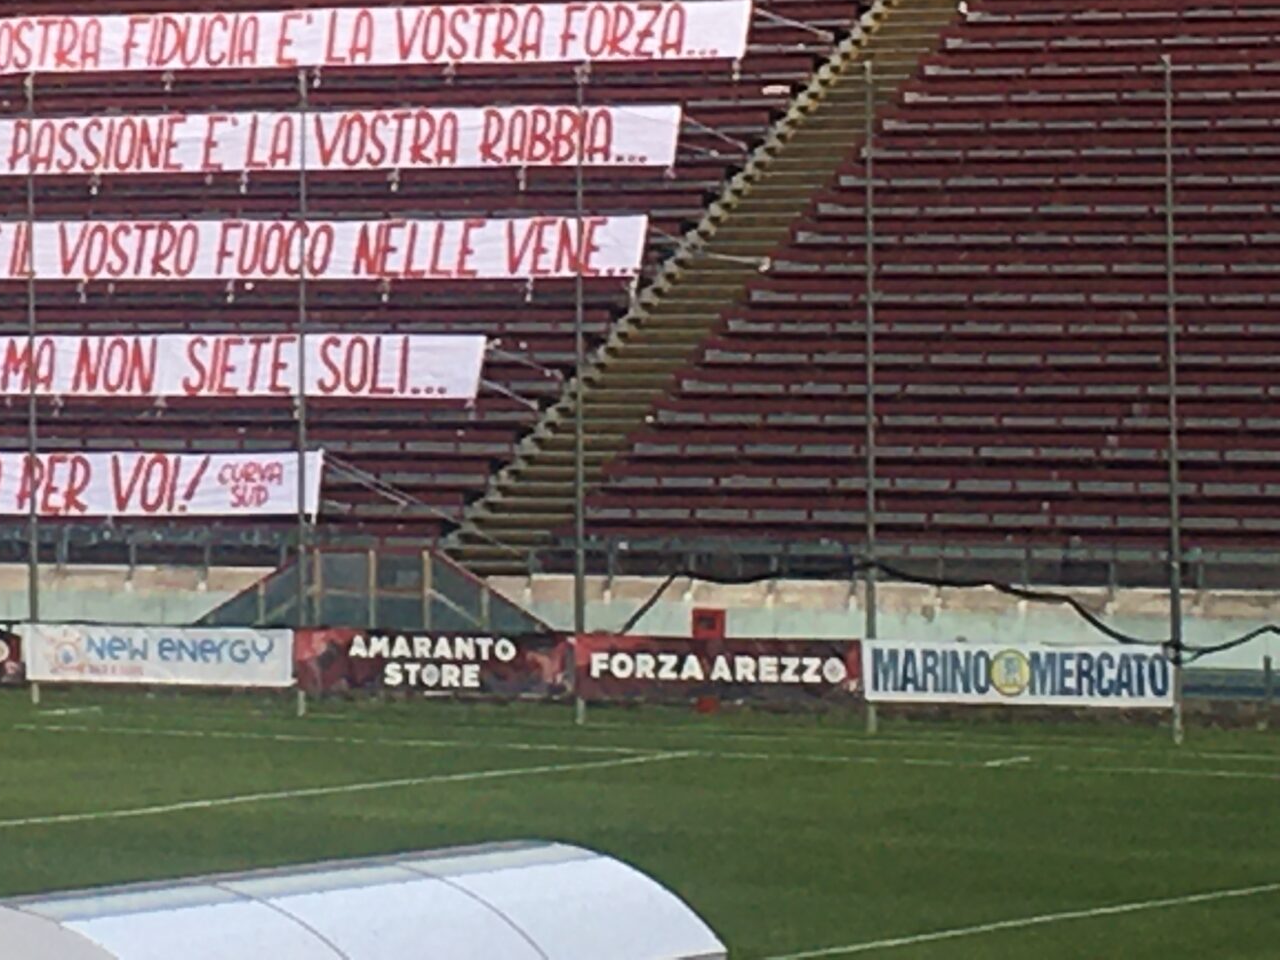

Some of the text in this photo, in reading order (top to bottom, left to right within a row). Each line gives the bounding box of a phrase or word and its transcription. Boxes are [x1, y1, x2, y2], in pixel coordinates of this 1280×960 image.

[122, 13, 260, 67] FIDUCIA
[325, 9, 373, 64] LA
[397, 5, 545, 61] VOSTRA
[559, 2, 719, 59] FORZA...
[8, 115, 187, 172] PASSIONE
[244, 113, 293, 169] LA
[314, 111, 458, 167] VOSTRA
[9, 222, 36, 278] IL
[58, 222, 199, 277] VOSTRO
[215, 221, 334, 277] FUOCO
[353, 218, 486, 278] NELLE
[506, 217, 641, 276] VENE...
[0, 337, 56, 391] MA
[72, 337, 158, 392] NON
[182, 335, 298, 394] SIETE
[316, 334, 448, 395] SOLI...
[17, 453, 91, 513] PER
[112, 453, 210, 513] VOI!
[218, 460, 284, 485] CURVA
[229, 485, 271, 508] SUD
[348, 634, 516, 661] AMARANTO
[591, 651, 847, 684] FORZA AREZZO
[872, 647, 990, 696] MARINO
[1028, 650, 1169, 697] MERCATO
[384, 662, 481, 688] STORE
